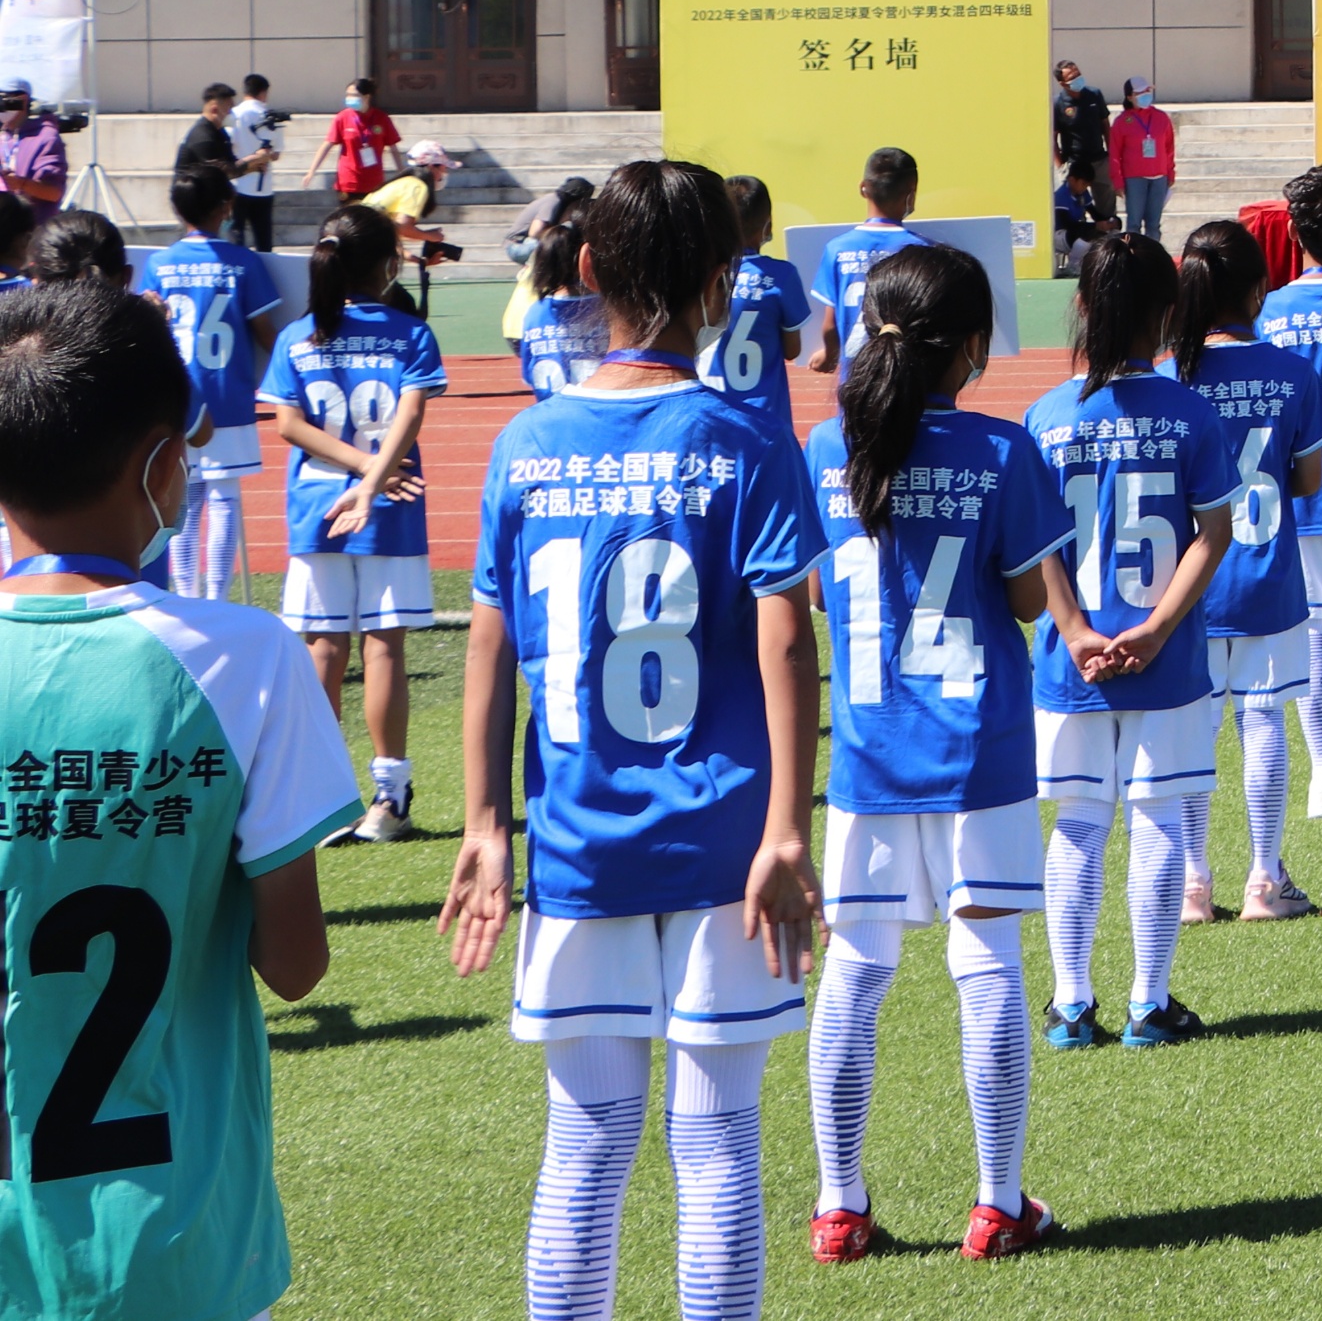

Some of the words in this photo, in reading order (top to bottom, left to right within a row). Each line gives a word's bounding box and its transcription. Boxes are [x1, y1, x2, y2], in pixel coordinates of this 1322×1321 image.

[691, 4, 1033, 21] 2022年全国青少年校园足球夏令营小学男女混合四年级组
[798, 37, 919, 71] 签名墙
[1050, 439, 1178, 468] 校园足球夏令营
[520, 486, 711, 517] 校园足球夏令营
[1064, 472, 1177, 611] 15
[529, 538, 699, 743] 18
[834, 535, 984, 705] 14
[0, 884, 174, 1183] 2
